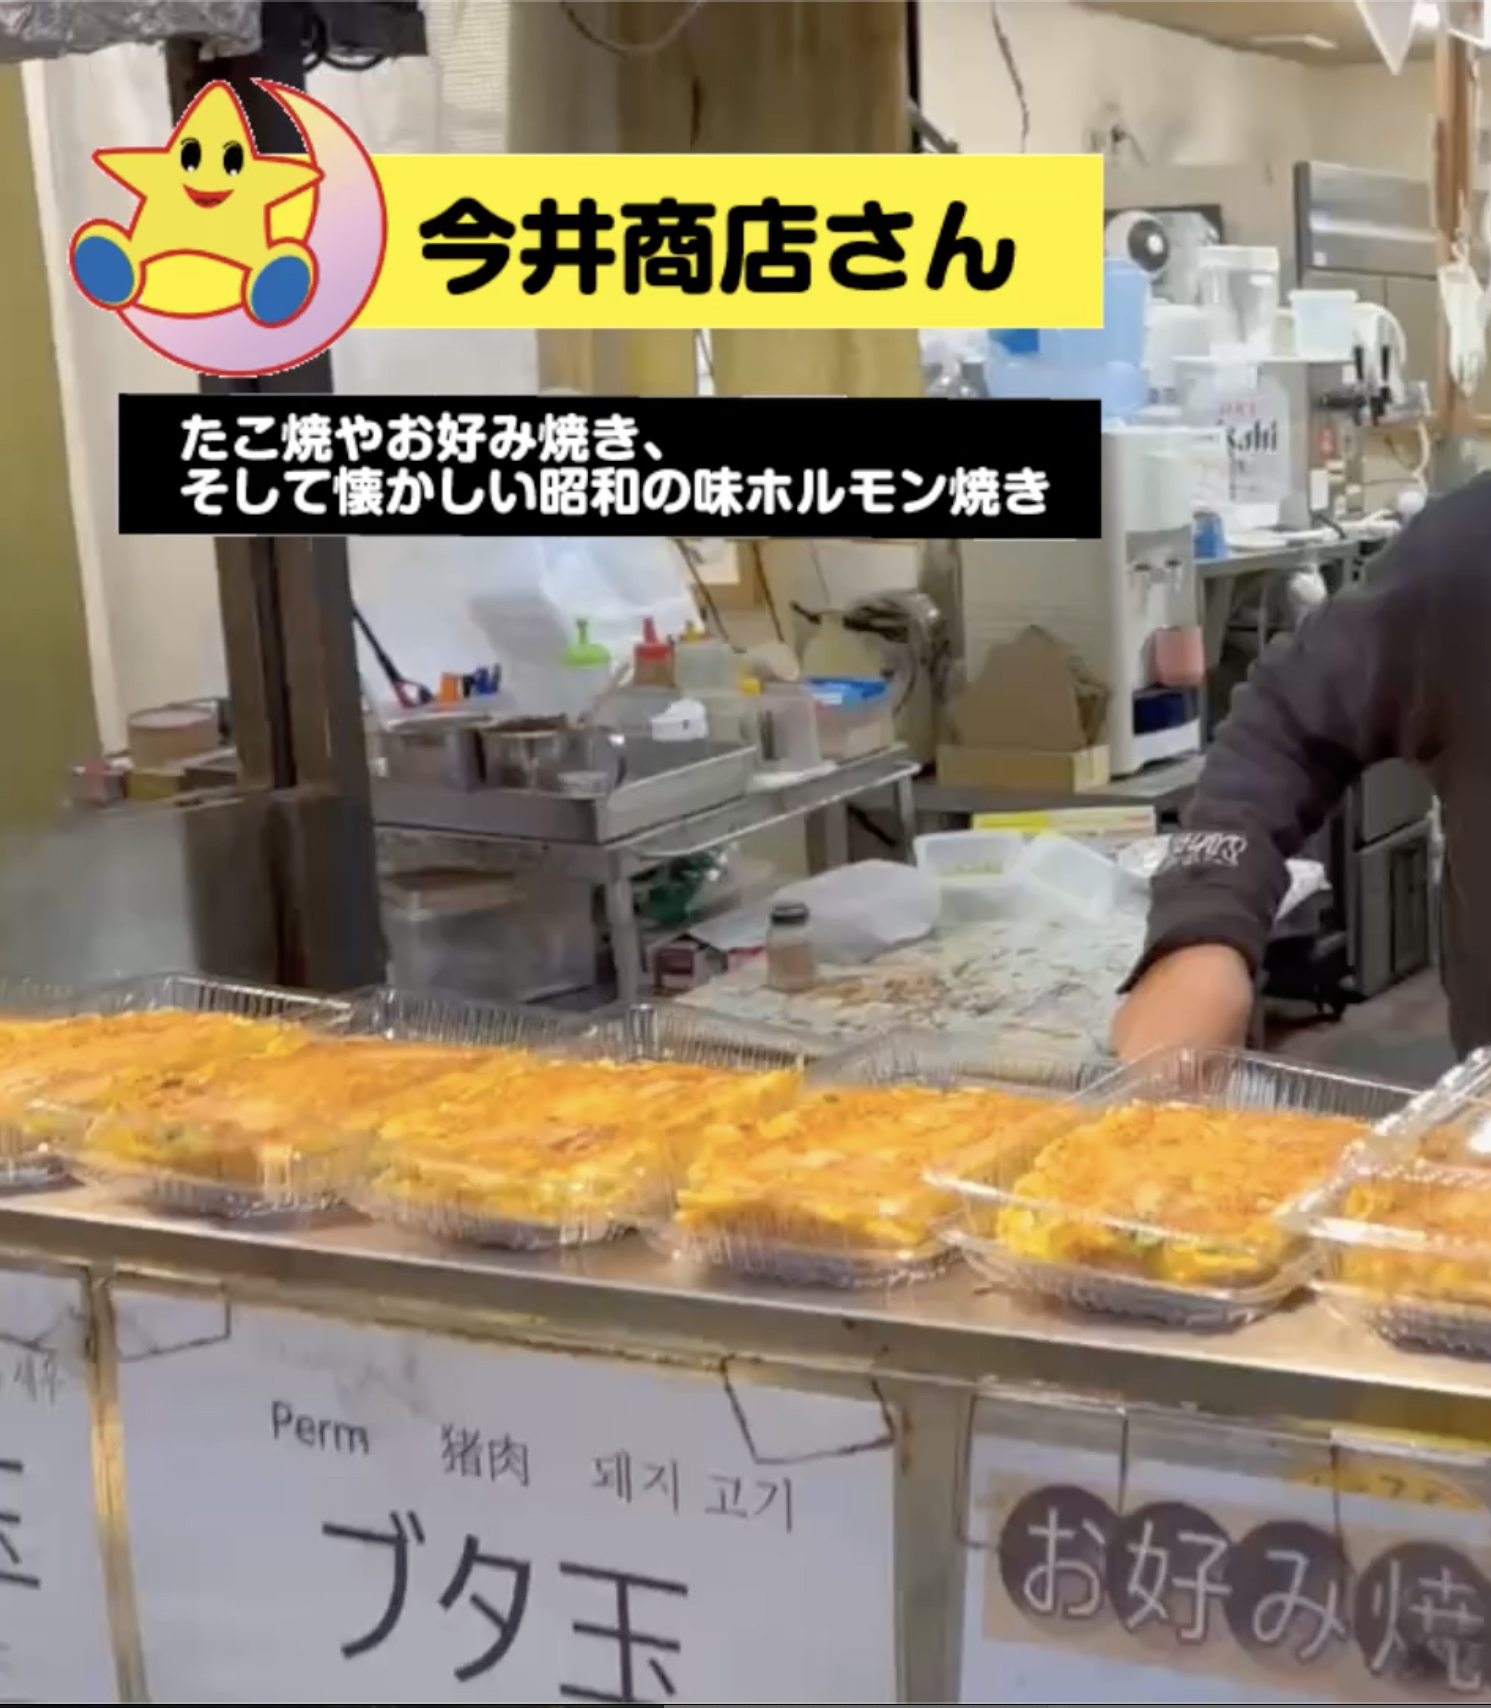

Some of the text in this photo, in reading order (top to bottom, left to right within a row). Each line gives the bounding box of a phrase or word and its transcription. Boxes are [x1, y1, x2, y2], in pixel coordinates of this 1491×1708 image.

[271, 1399, 370, 1455] Perm
[441, 1423, 530, 1488] 猪肉
[704, 1475, 793, 1534] 고기
[322, 1510, 689, 1702] ブタ玉
